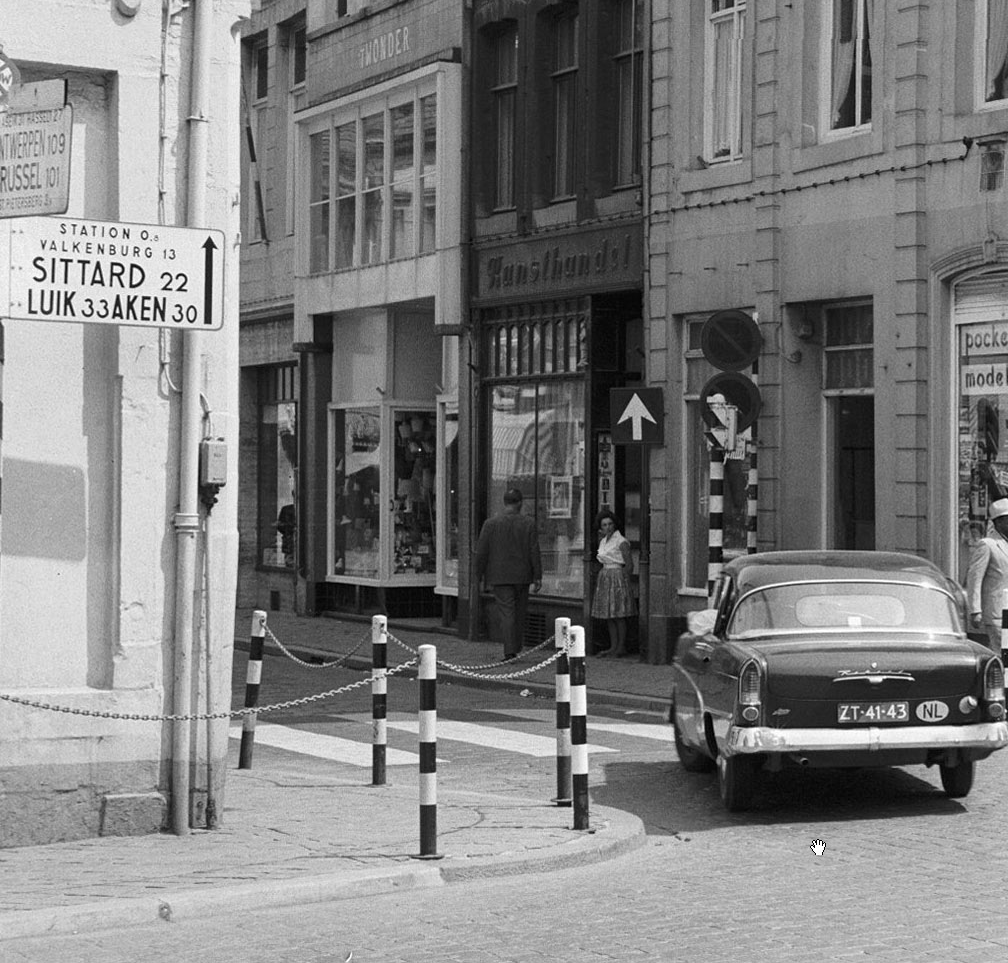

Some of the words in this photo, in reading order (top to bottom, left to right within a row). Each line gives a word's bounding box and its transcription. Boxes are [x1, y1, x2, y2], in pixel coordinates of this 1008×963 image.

[48, 133, 66, 155] 109
[46, 167, 60, 188] 101
[59, 223, 131, 240] STATION
[40, 239, 153, 258] VALKENBURG
[163, 248, 177, 260] 13
[32, 256, 146, 289] SITTARD
[160, 272, 188, 292] 22
[28, 288, 77, 317] LUIK
[81, 298, 109, 318] 33
[112, 294, 167, 322] AKEN
[172, 304, 198, 324] 30
[840, 703, 907, 721] ZT-41-43
[923, 703, 943, 719] NL
